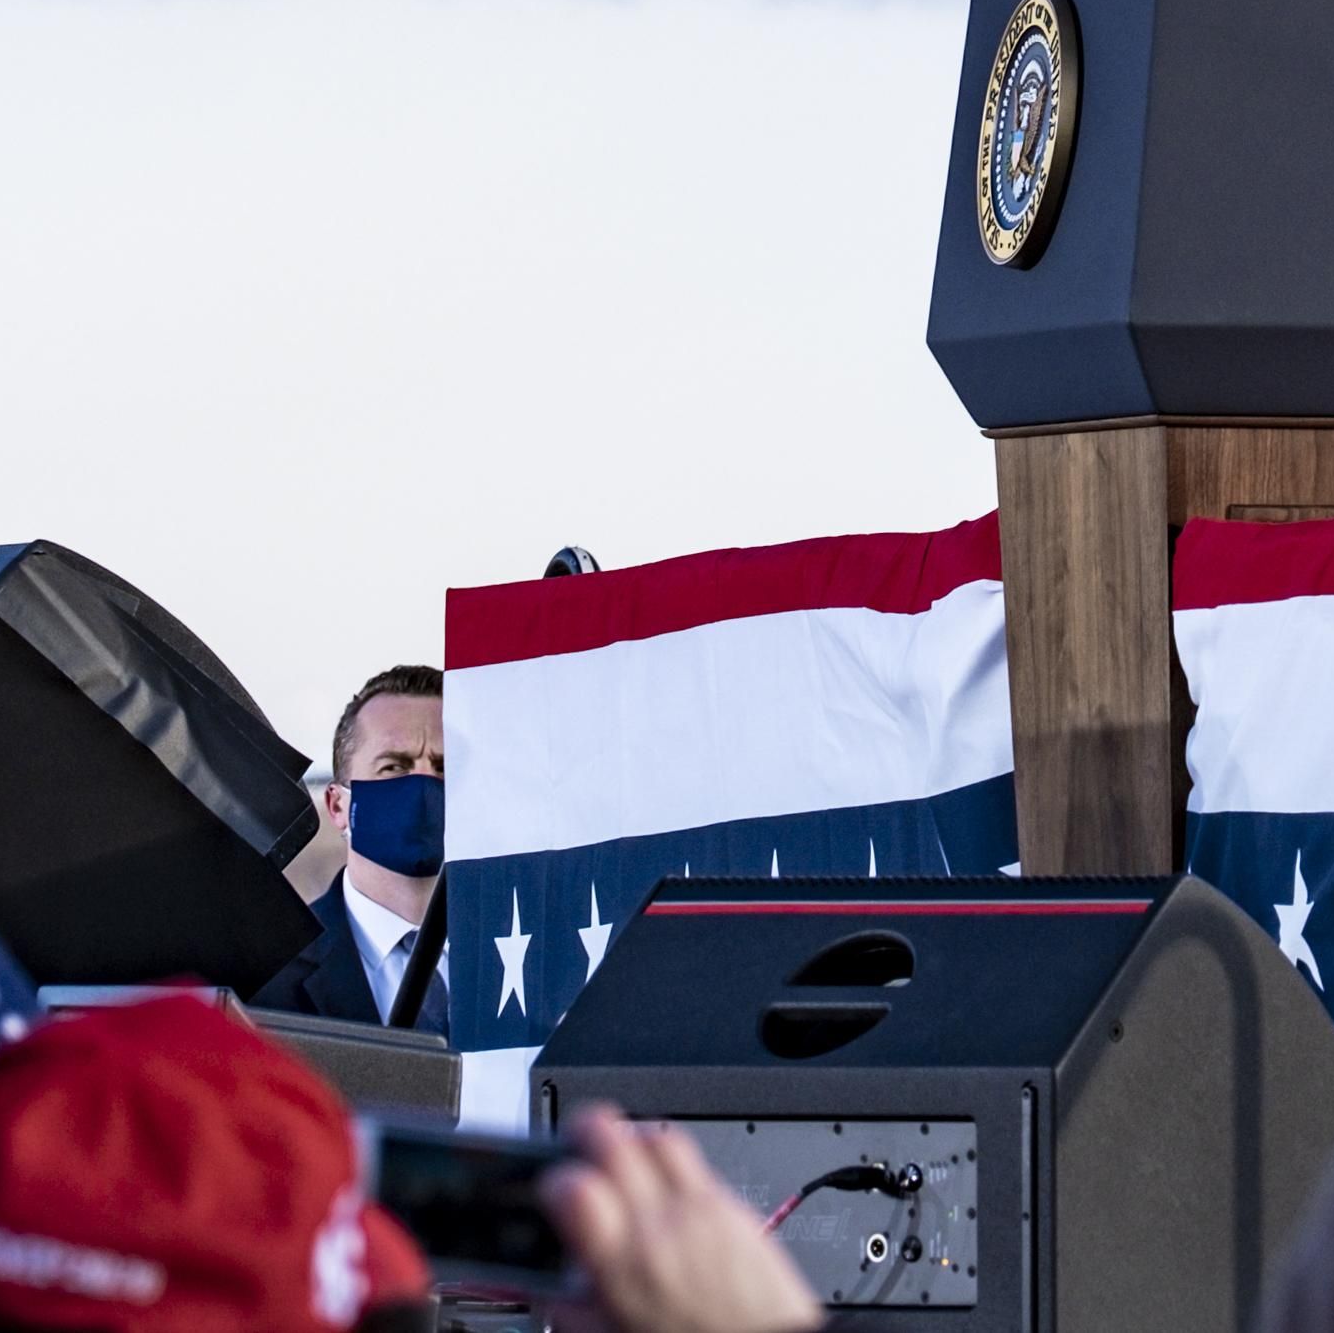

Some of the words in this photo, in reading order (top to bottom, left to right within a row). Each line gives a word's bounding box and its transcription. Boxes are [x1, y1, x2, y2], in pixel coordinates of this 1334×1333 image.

[1036, 4, 1044, 19] OF
[986, 2, 1035, 122] PRESIDENT
[1049, 31, 1060, 140] UNITED
[983, 197, 1000, 250] SEAL
[1012, 168, 1047, 250] STATES
